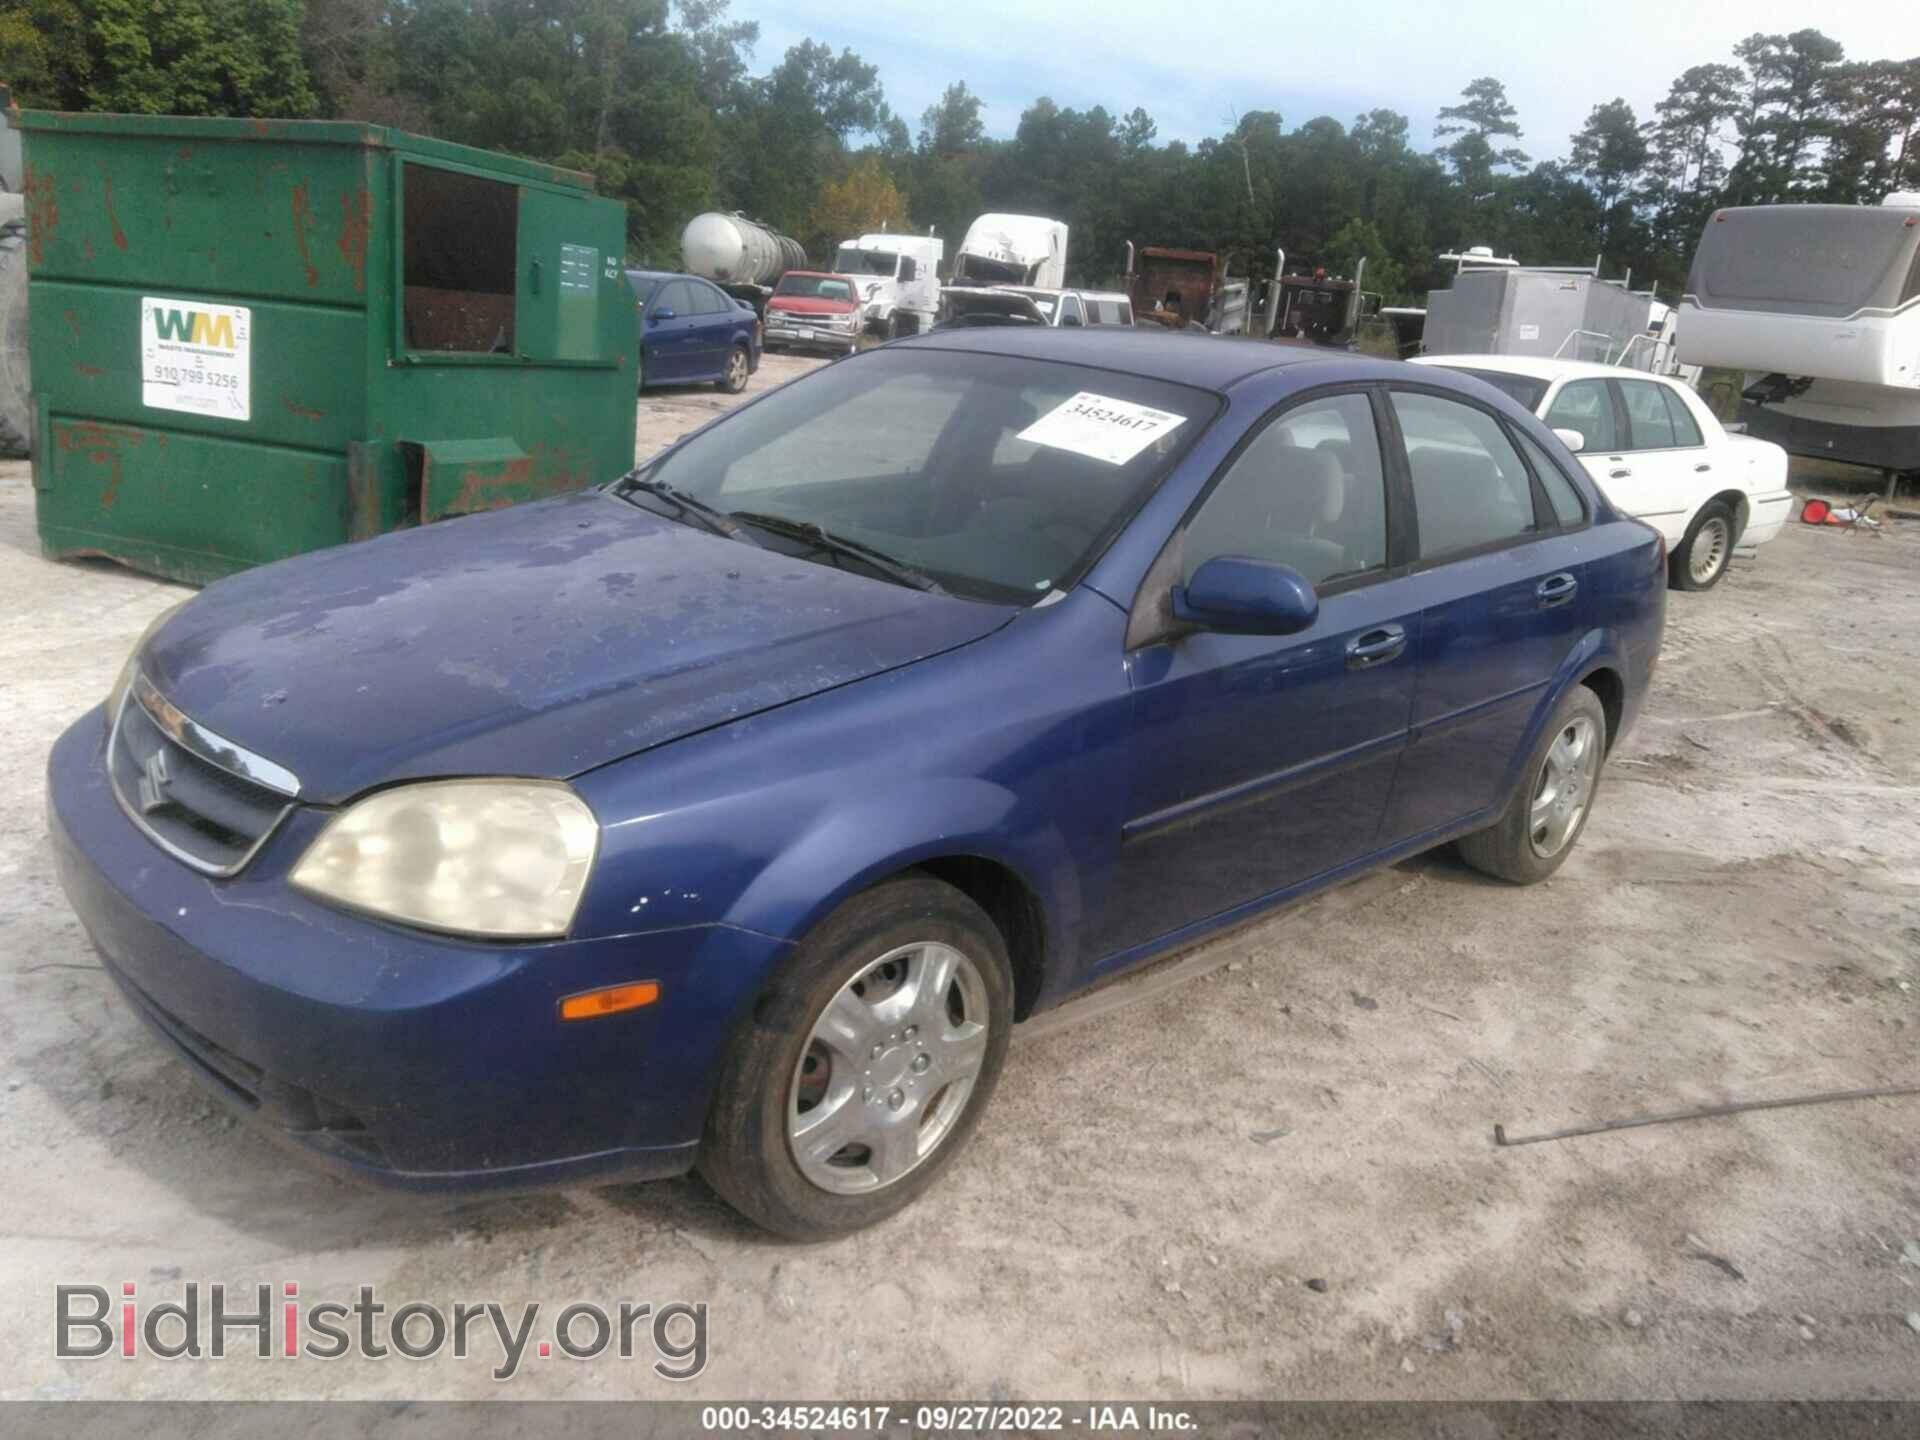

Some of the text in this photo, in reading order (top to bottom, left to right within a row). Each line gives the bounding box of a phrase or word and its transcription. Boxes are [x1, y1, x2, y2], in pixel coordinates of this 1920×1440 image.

[154, 307, 235, 350] WM
[154, 365, 239, 389] 910 799 5256
[1066, 403, 1159, 432] 34524617
